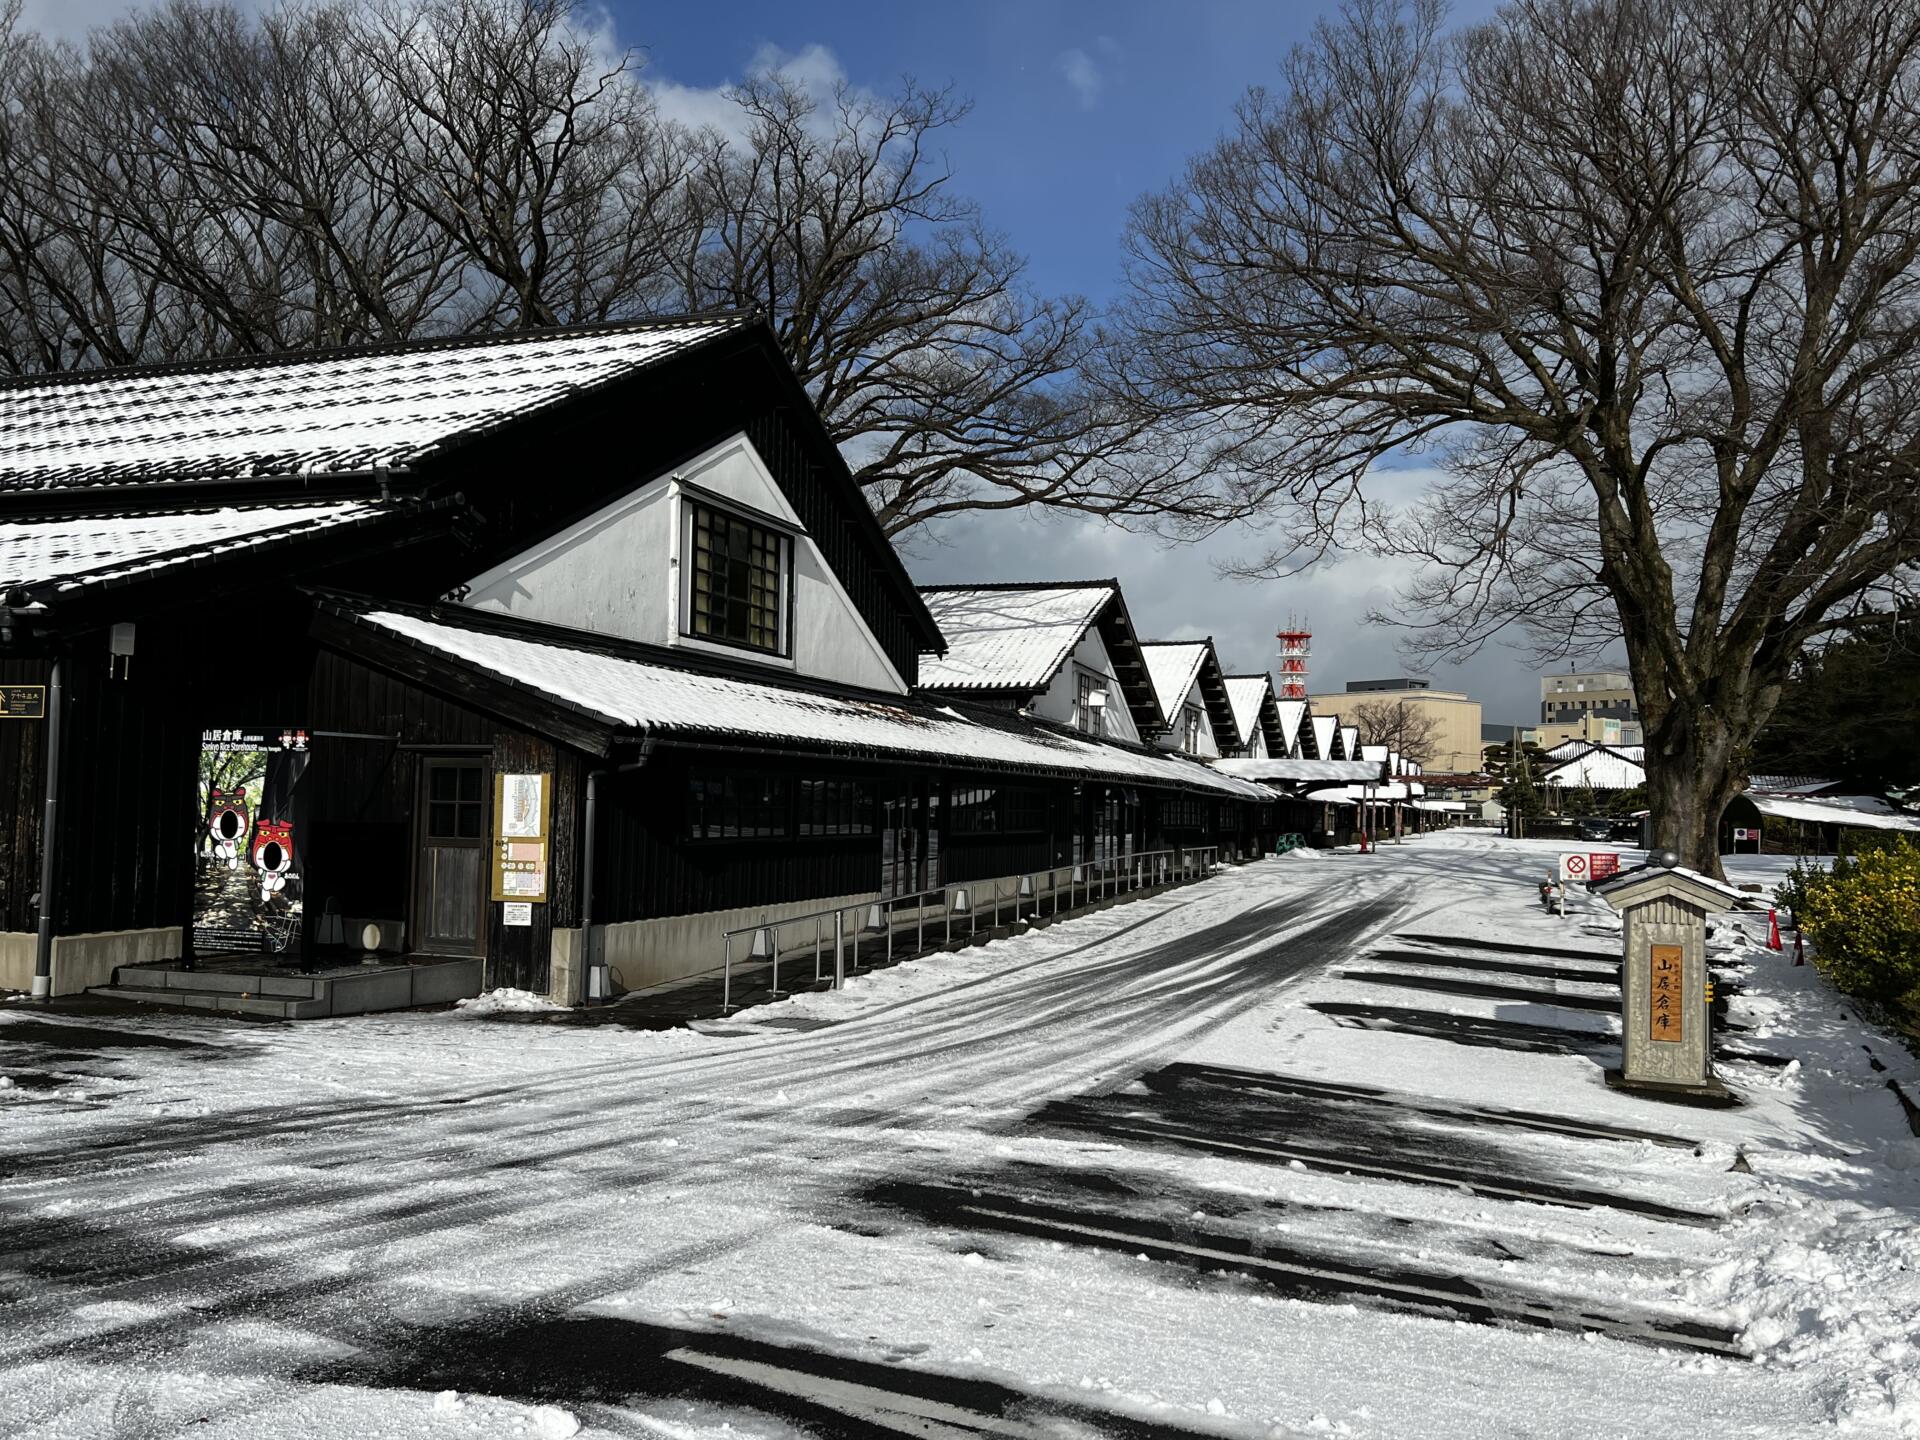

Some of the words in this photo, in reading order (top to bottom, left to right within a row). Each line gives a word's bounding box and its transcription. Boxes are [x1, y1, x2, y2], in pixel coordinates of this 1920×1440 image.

[202, 729, 242, 741] 山居倉庫
[202, 742, 219, 752] Sankyo
[220, 743, 230, 751] Rice
[231, 743, 257, 751] Storehouse
[1656, 958, 1672, 1032] 山居倉庫
